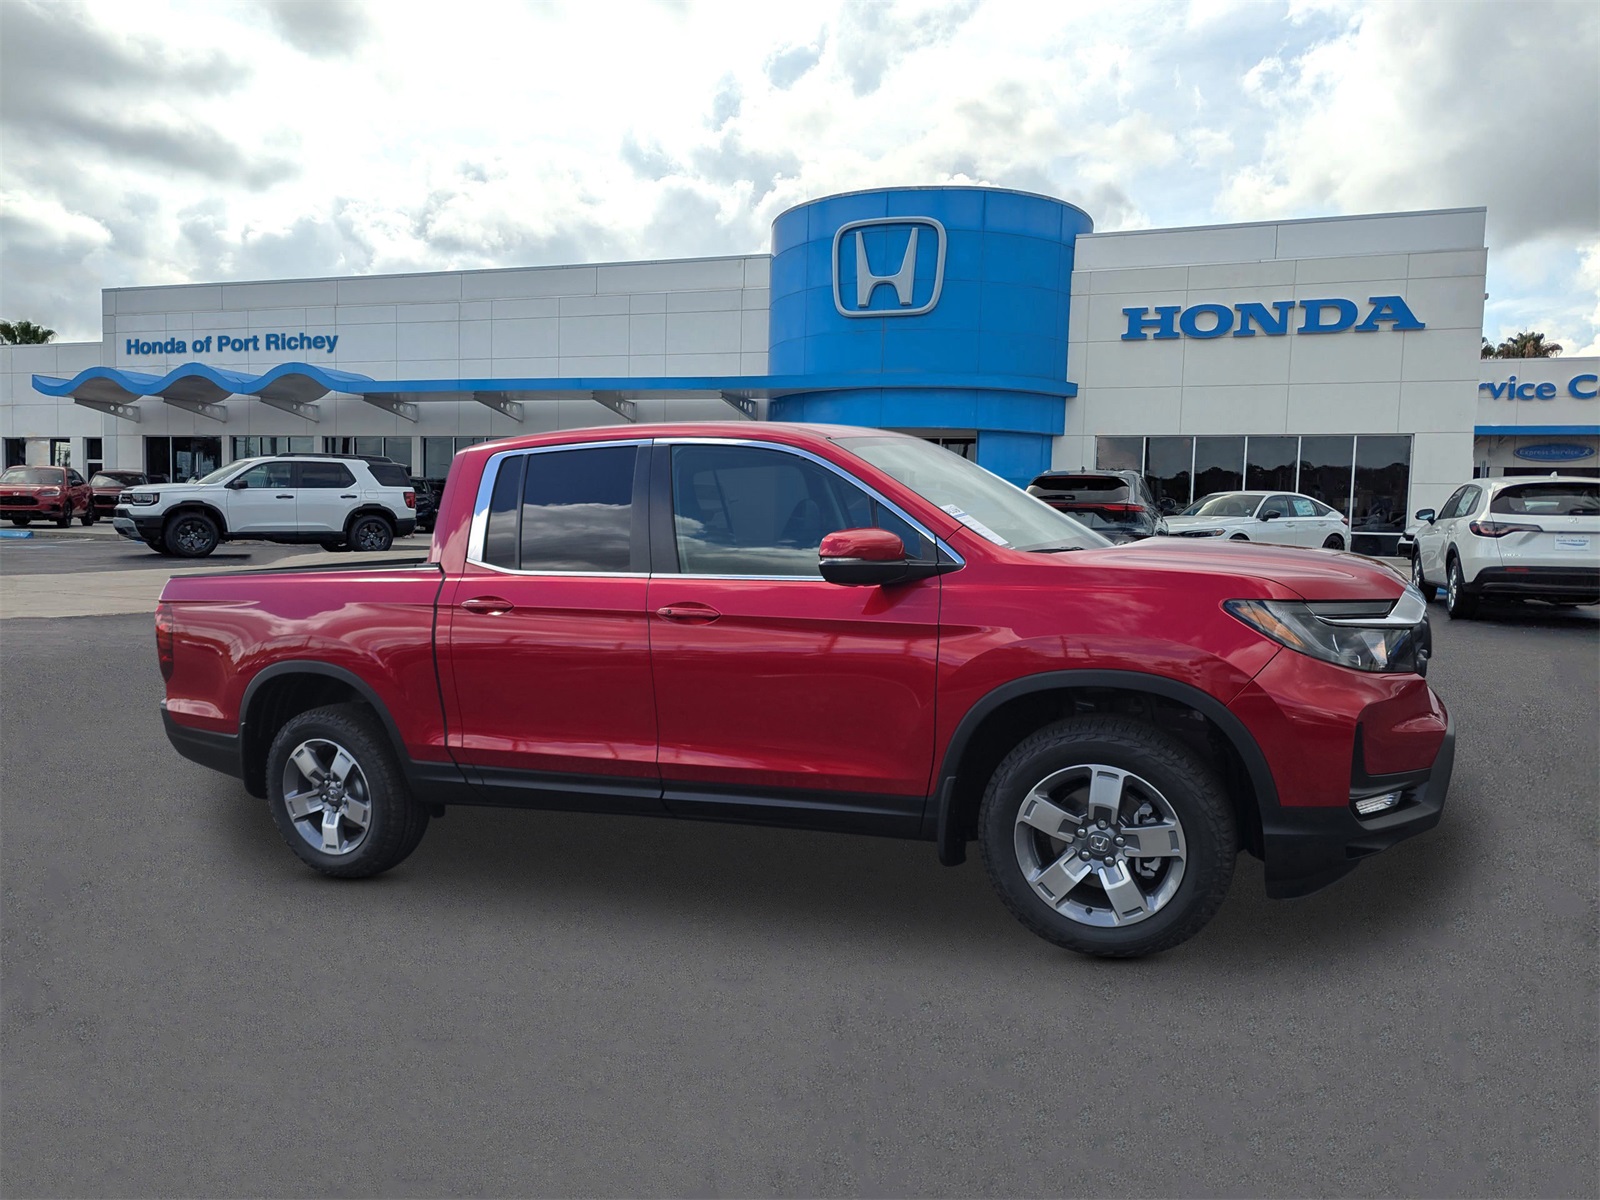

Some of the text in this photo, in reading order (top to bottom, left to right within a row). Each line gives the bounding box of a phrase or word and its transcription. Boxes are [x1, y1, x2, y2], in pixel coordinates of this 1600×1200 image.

[1121, 295, 1426, 341] HONDA
[126, 332, 339, 355] Honda of Port Richey
[1567, 374, 1600, 400] C
[1519, 448, 1579, 456] Express Service
